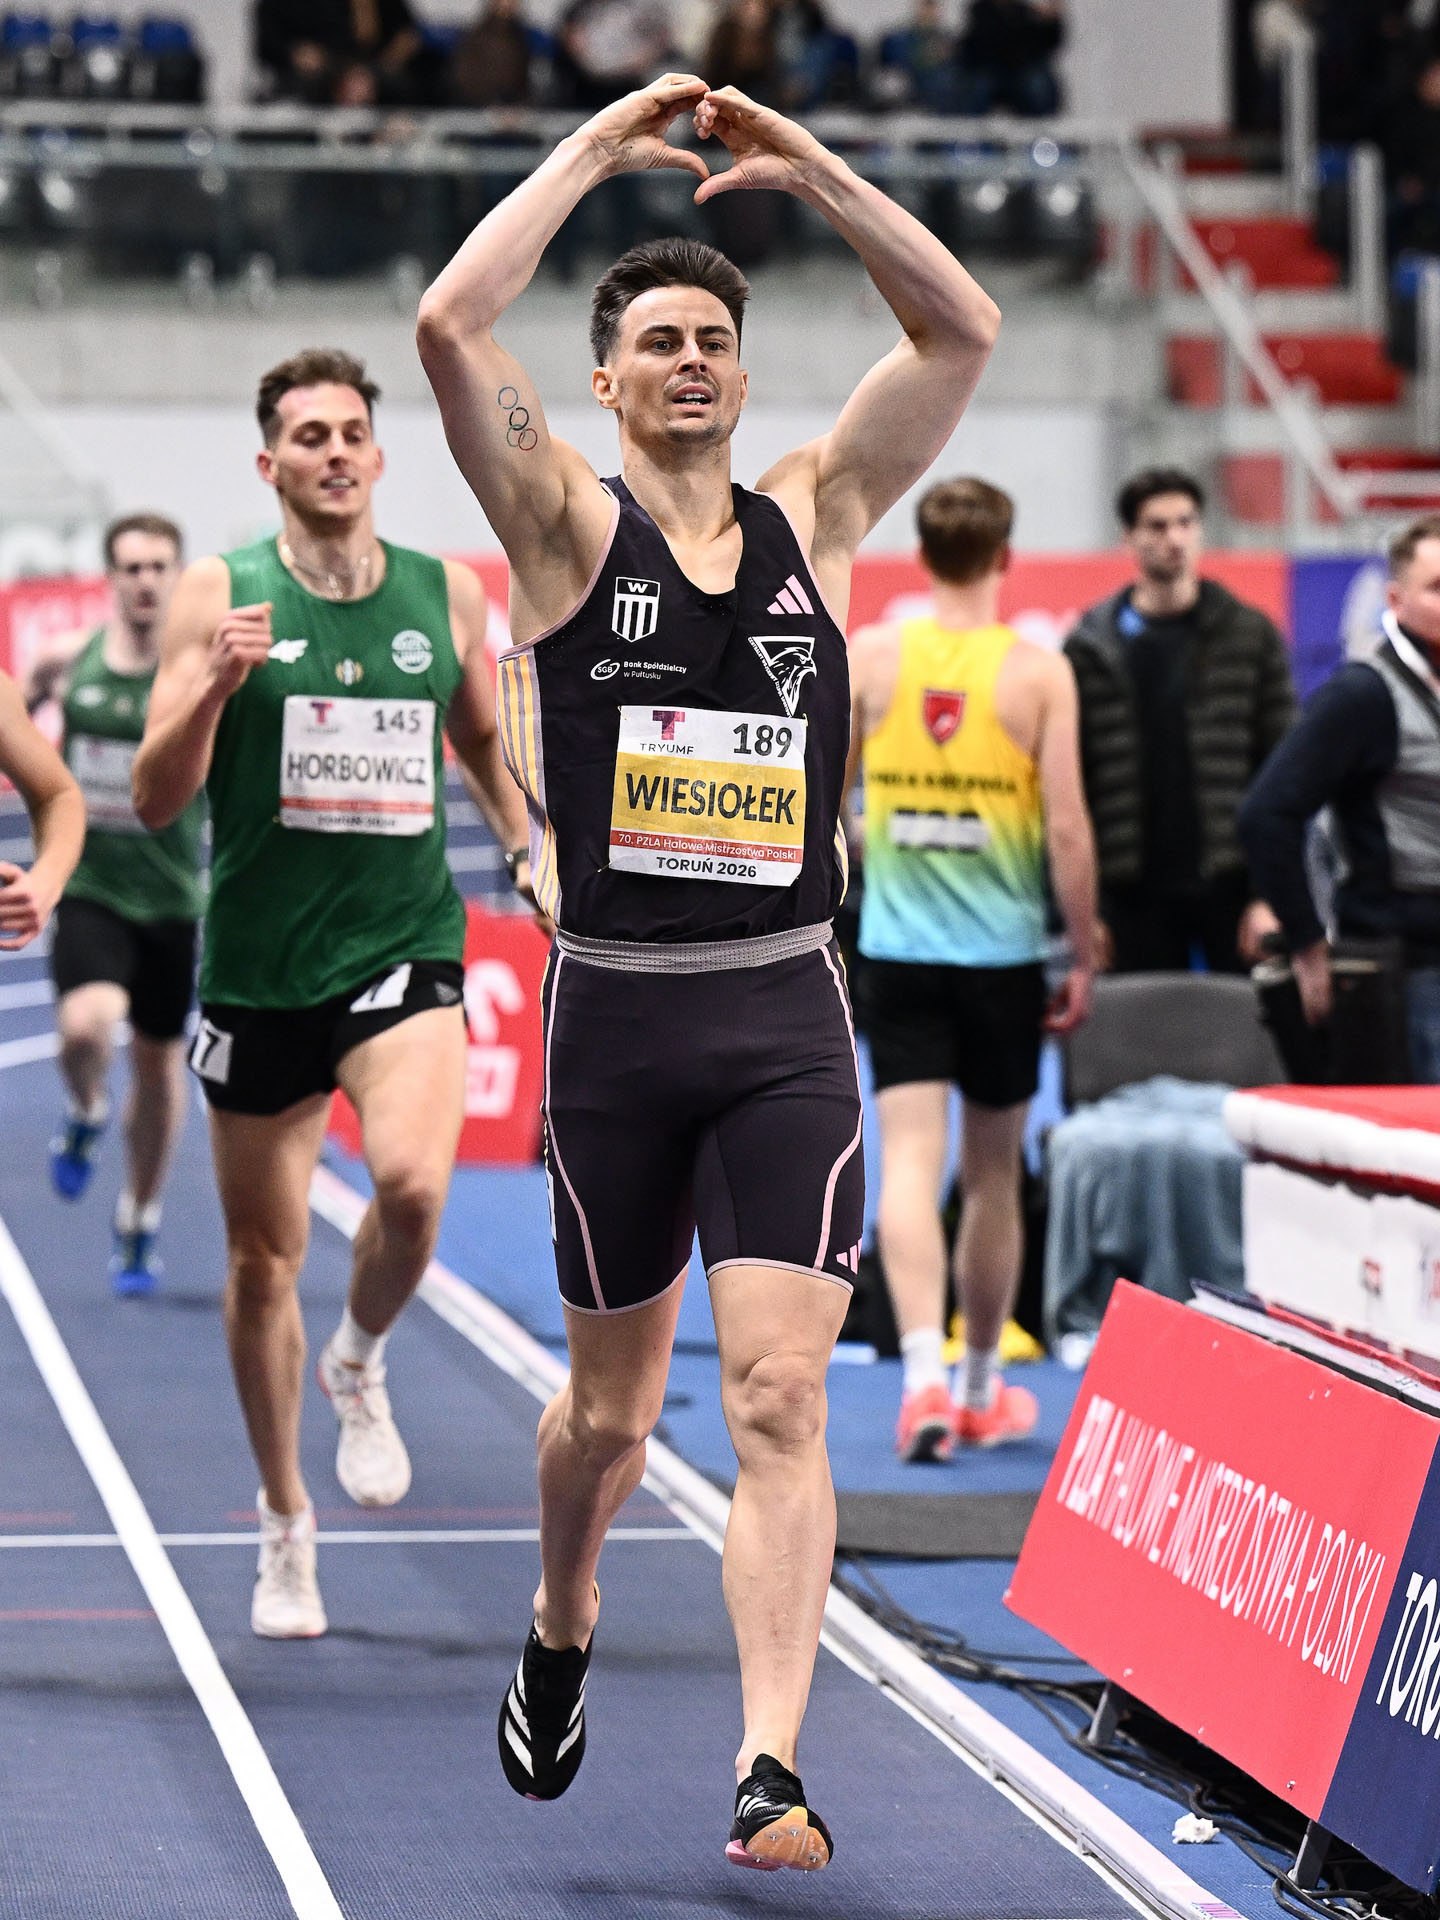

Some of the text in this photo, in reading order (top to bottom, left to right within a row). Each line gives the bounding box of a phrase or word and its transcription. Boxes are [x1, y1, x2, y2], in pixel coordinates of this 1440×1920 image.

[627, 581, 649, 594] W
[597, 666, 613, 674] SGB
[623, 661, 687, 674] Bank Spółdzielczy
[373, 709, 421, 734] 145
[639, 743, 694, 755] TRYUMF
[733, 723, 793, 758] 189
[287, 752, 426, 785] HORBOWICZ
[625, 773, 797, 825] WIESIOŁEK
[618, 834, 797, 860] 70. PZLA Halowe Mistrzostwa Polski
[656, 856, 757, 878] TORUŃ 2026
[1056, 1393, 1386, 1685] PZLA HALOWE MISTRZOSTWA POLSKI
[1375, 1571, 1440, 1740] TOR
